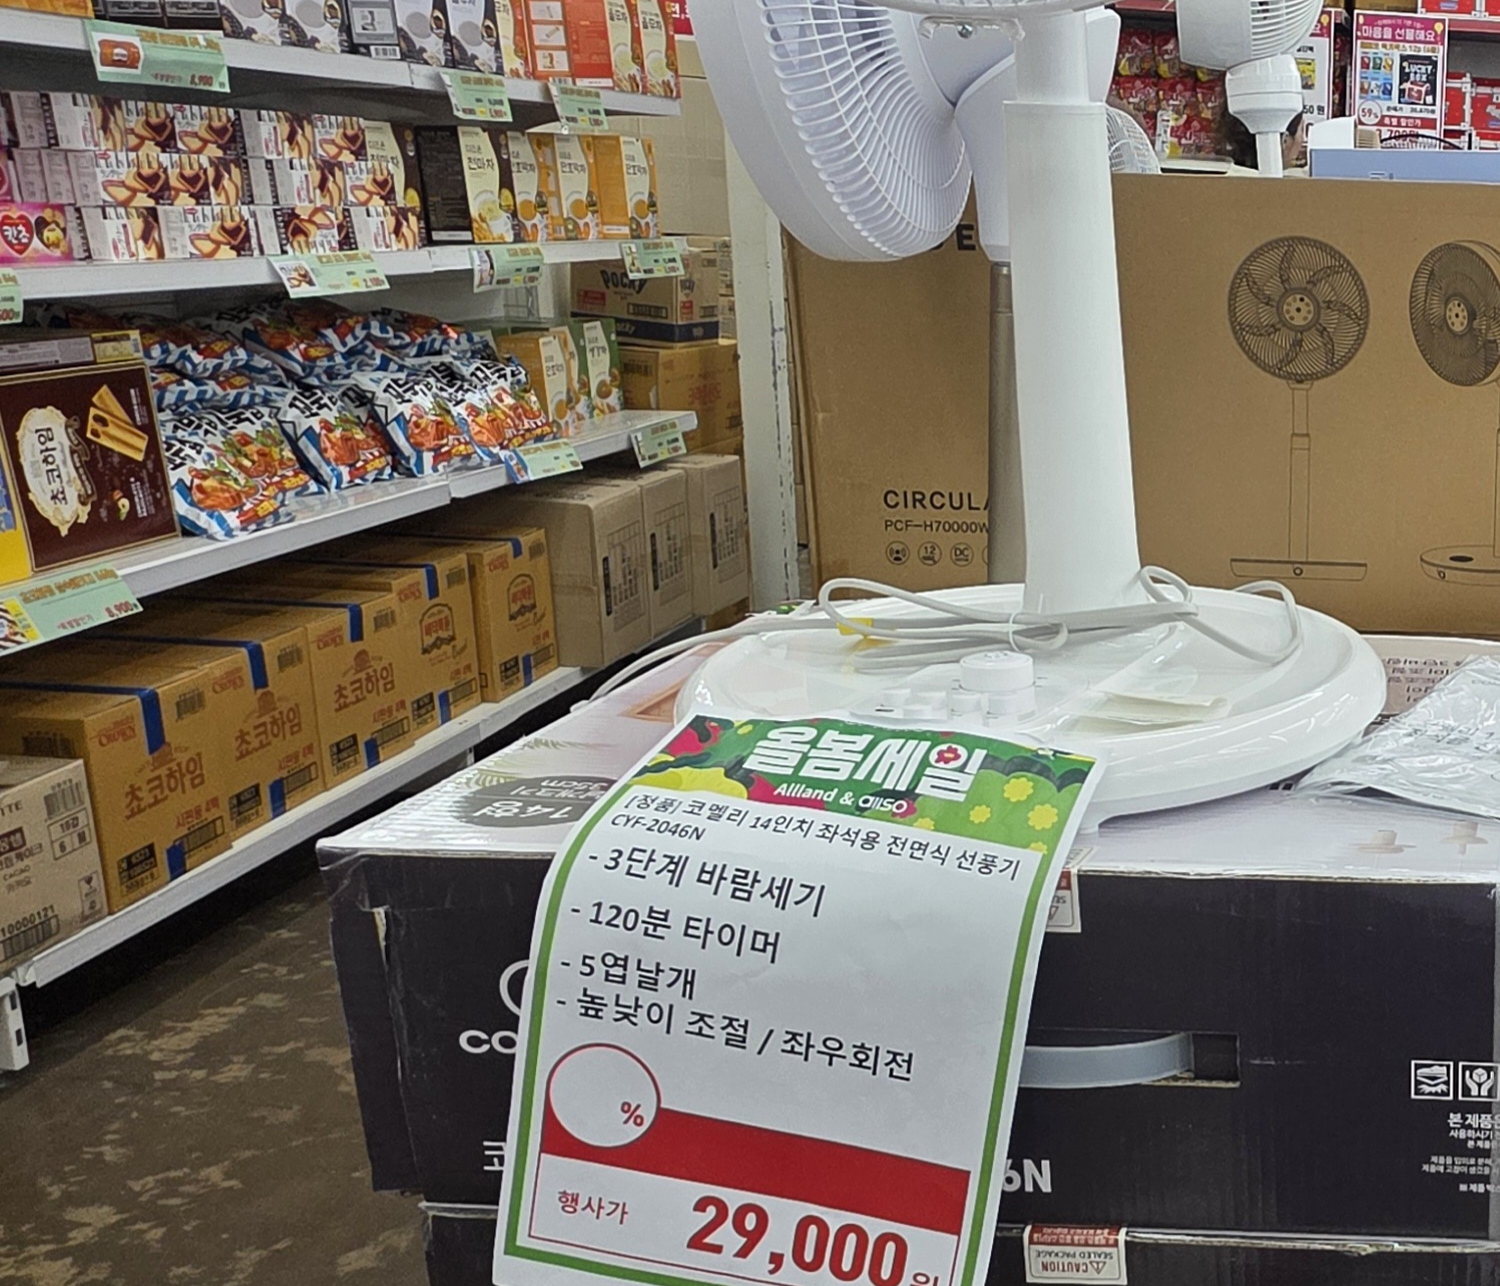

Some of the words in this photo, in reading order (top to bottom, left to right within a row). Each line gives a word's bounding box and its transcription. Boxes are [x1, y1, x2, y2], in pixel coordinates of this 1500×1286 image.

[1362, 25, 1392, 40] 마음을
[1394, 27, 1436, 42] 선물해요
[1404, 63, 1433, 75] LUCKY
[35, 425, 68, 507] 초코하임
[334, 660, 397, 715] 초코하임
[234, 701, 302, 763] 초코하임
[123, 750, 206, 822] 초코하임
[743, 726, 988, 803] 올봄세일
[609, 812, 707, 843] CYF-2046N
[624, 792, 681, 819] [정품]
[685, 797, 747, 829] 코멜리
[749, 810, 813, 841] 14인치
[814, 821, 881, 853] 좌석용
[885, 834, 950, 868] 전면식
[953, 847, 1022, 882] 선풍기
[602, 845, 691, 890] 3단계
[694, 860, 828, 919] 바람세기
[587, 899, 674, 942] 120분
[681, 916, 783, 966] 타이머
[577, 951, 698, 1002] 5엽날개
[575, 986, 675, 1037] 높낮이
[683, 1007, 751, 1049] 조절
[780, 1029, 916, 1083] 좌우회전
[619, 1101, 646, 1128] %
[556, 1189, 630, 1228] 행사가
[1034, 1249, 1078, 1260] PACKAGE
[1041, 1260, 1089, 1274] CAUTION
[1079, 1250, 1115, 1260] SEALED
